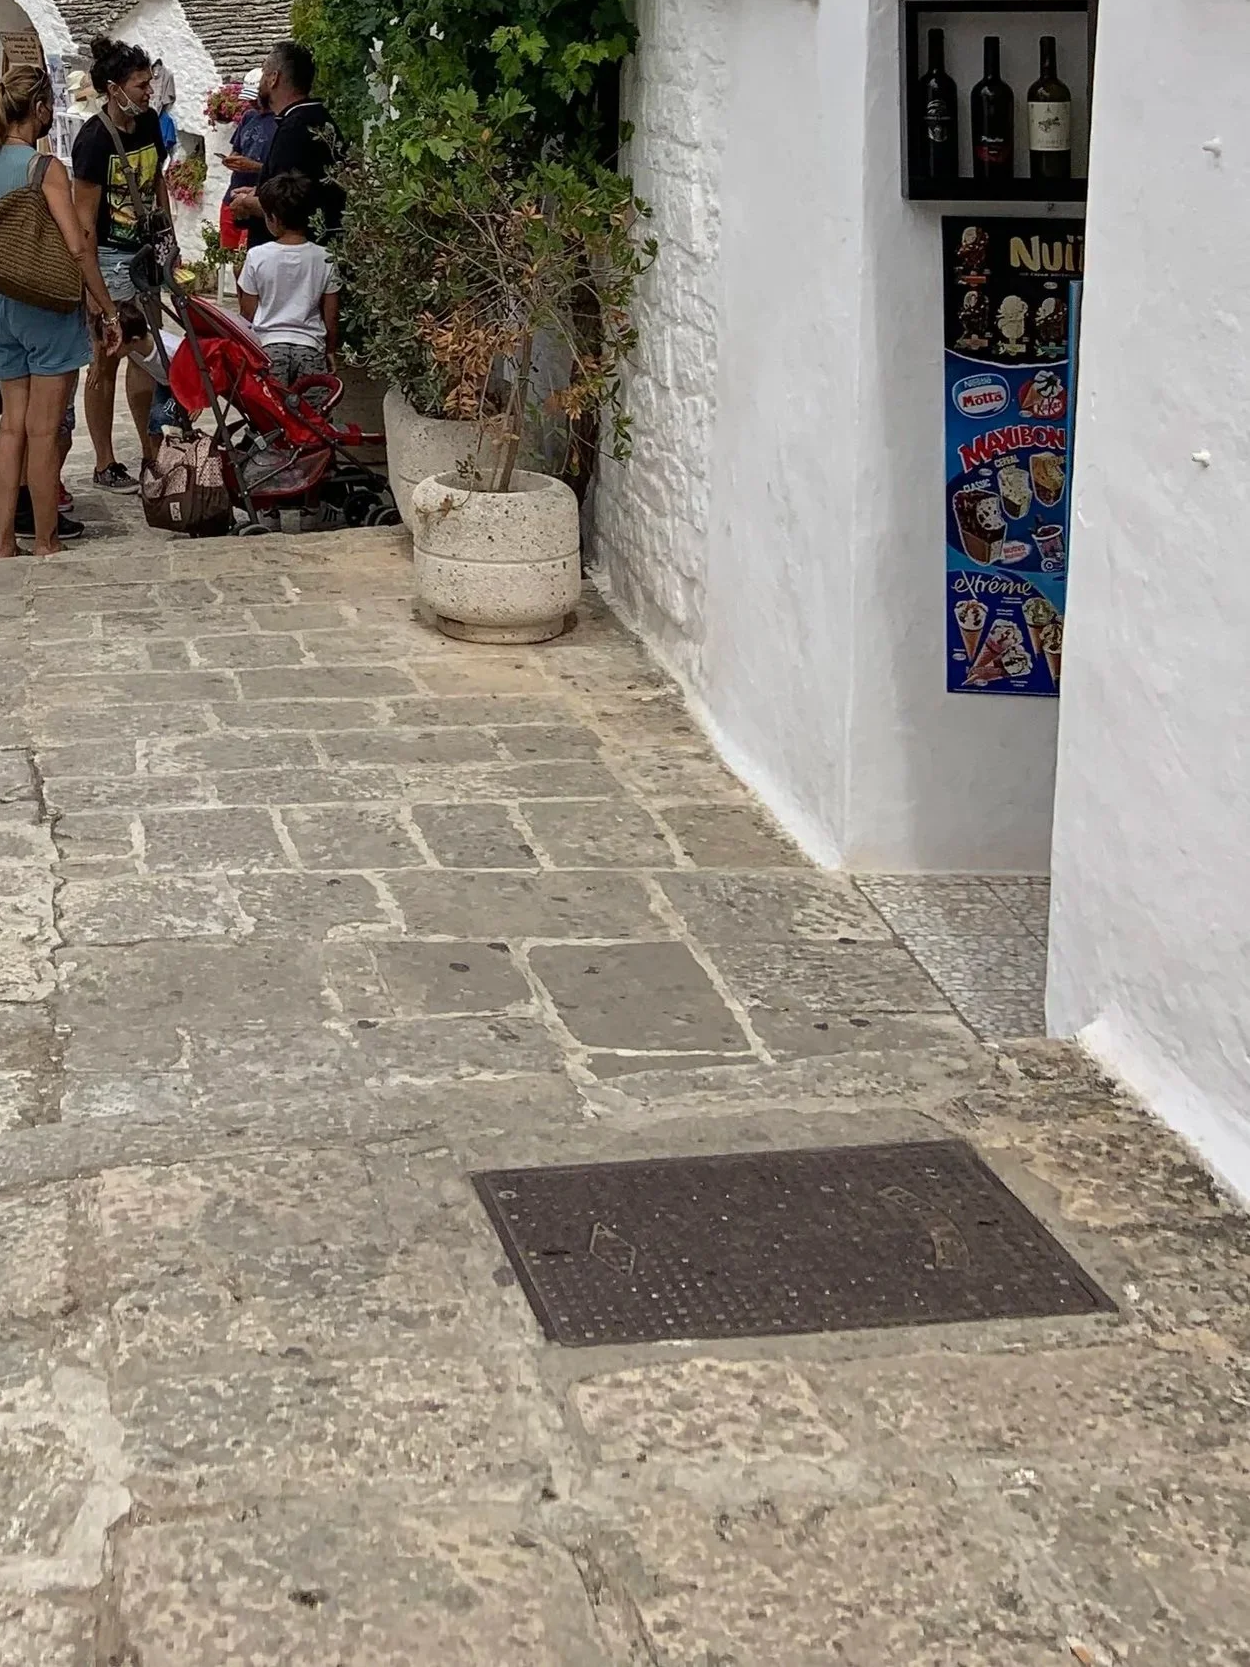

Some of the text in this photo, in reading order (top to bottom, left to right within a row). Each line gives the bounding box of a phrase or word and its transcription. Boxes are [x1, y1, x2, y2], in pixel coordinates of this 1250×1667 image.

[962, 391, 1004, 408] Motta
[957, 424, 1066, 474] MAXIBON
[994, 454, 1020, 468] CEREAL
